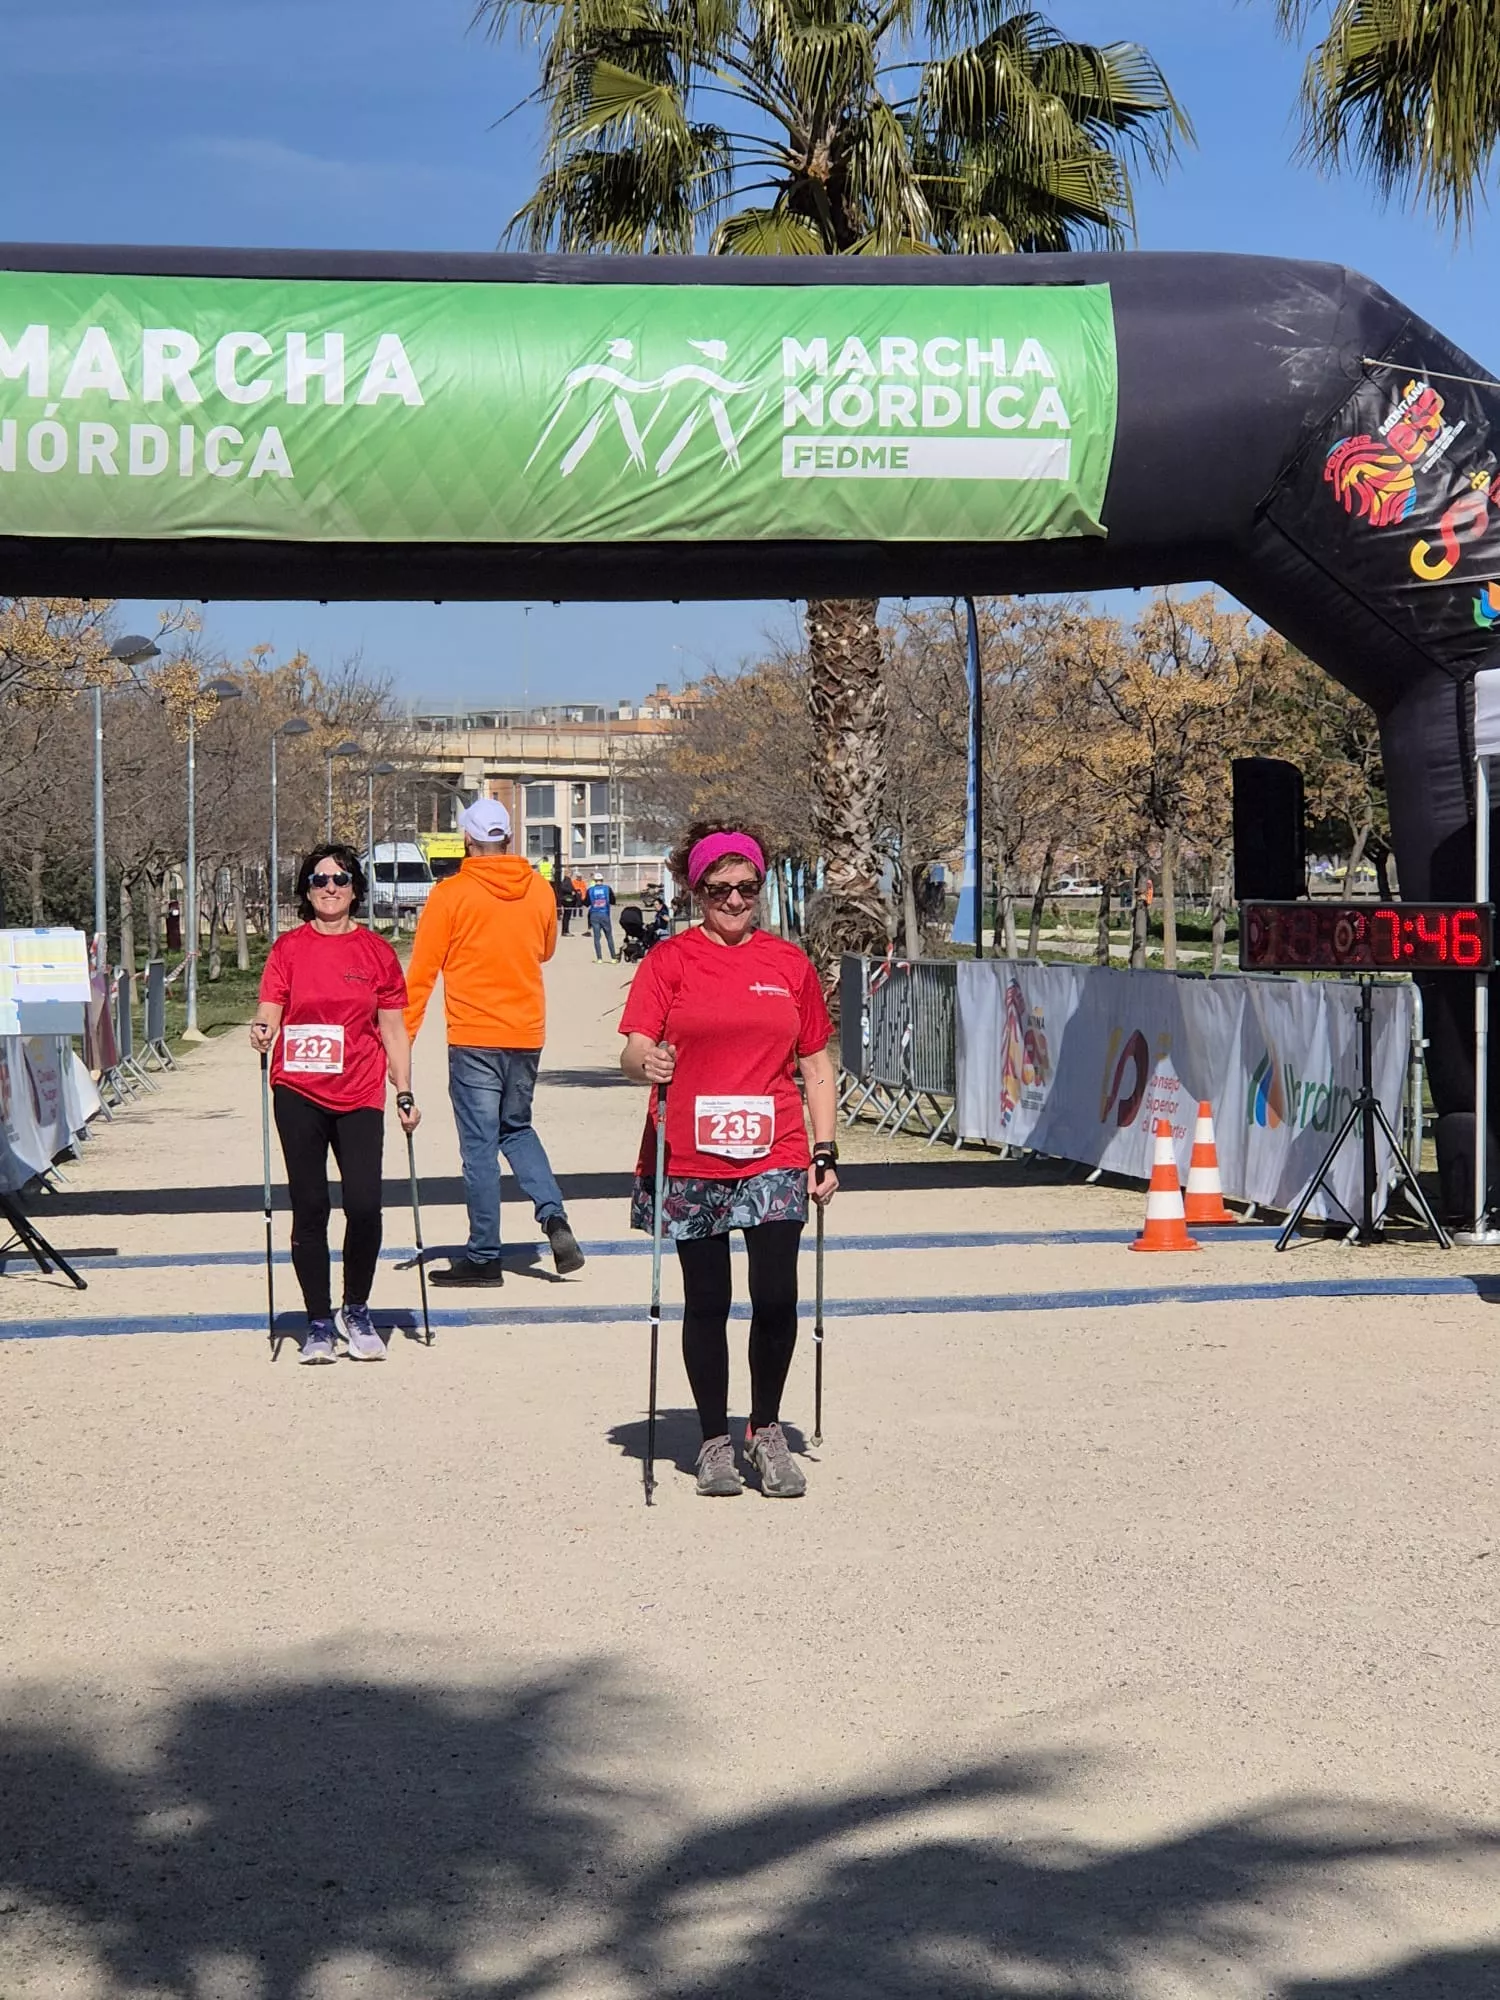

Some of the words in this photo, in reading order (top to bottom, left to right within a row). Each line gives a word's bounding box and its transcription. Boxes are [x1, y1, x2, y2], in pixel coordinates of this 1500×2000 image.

[782, 337, 1057, 378] MARCHA
[782, 373, 1071, 430] NÓRDICA
[794, 446, 910, 470] FEDME
[295, 1038, 333, 1058] 232
[710, 1114, 761, 1140] 235
